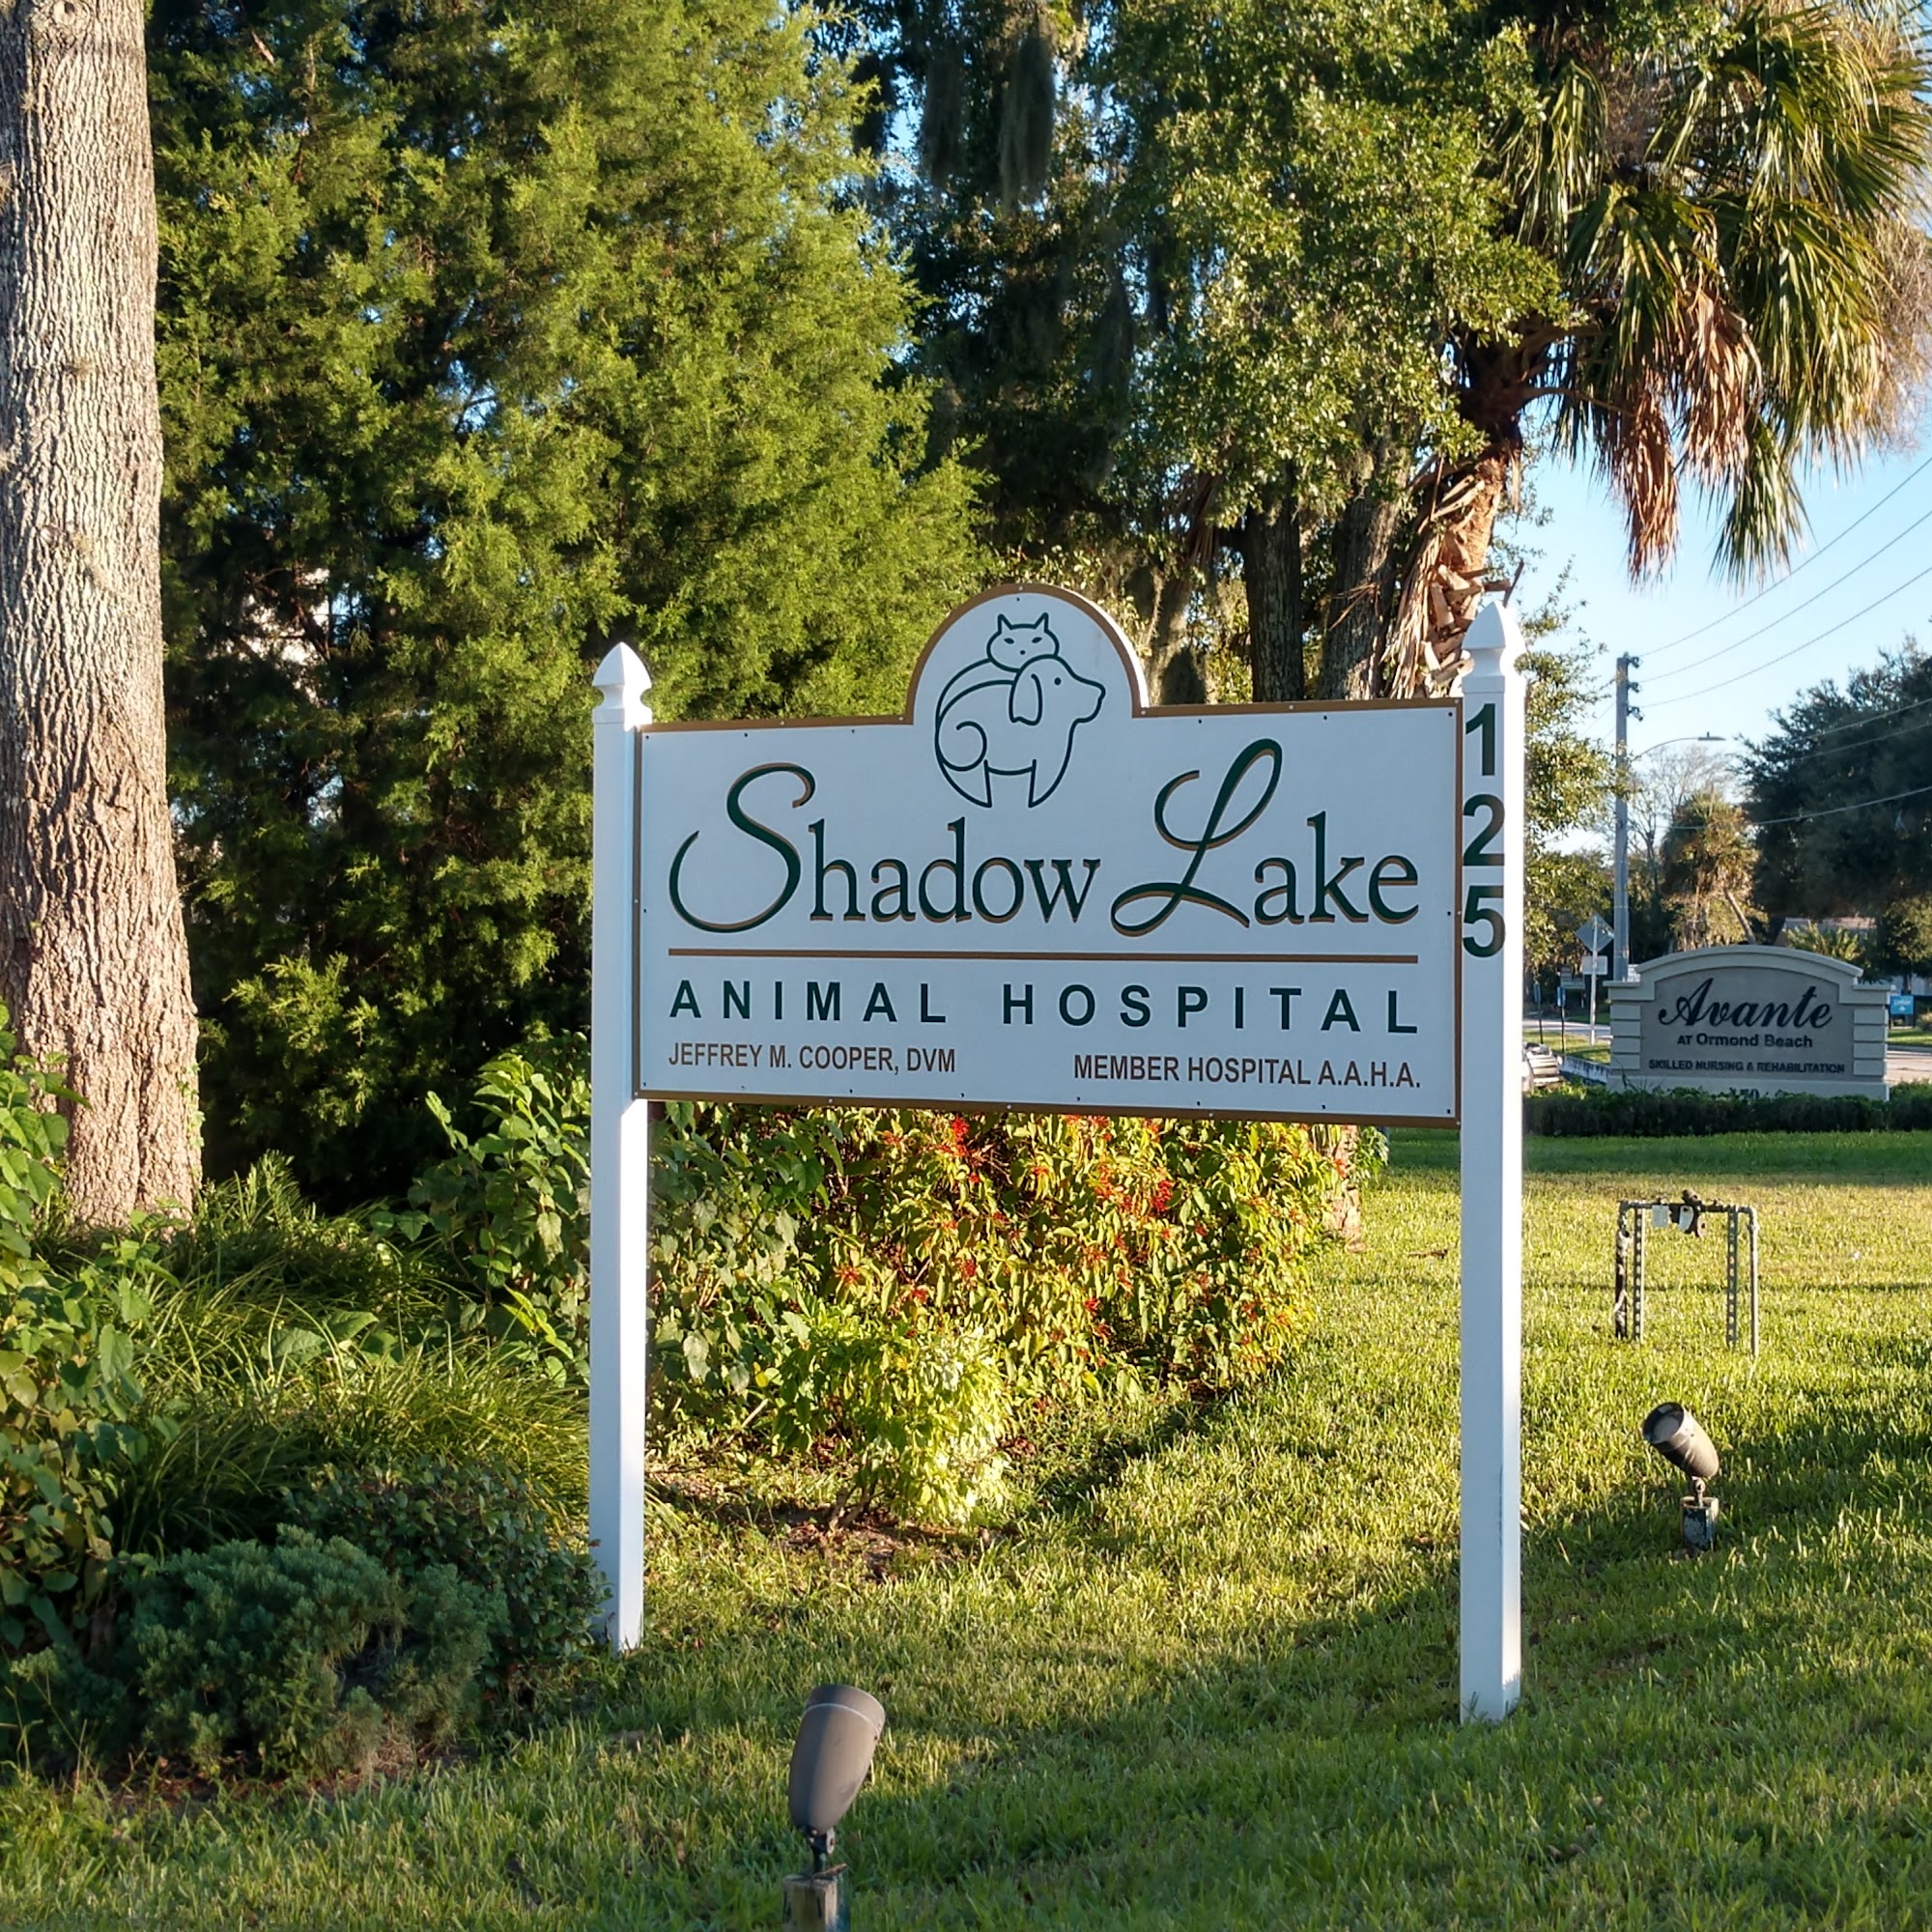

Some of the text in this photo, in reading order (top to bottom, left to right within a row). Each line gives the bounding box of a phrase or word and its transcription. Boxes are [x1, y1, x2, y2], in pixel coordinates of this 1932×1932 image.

[668, 737, 1420, 938] Shadow Lake
[1462, 703, 1505, 958] 125
[669, 980, 1418, 1035] ANIMAL HOSPITAL
[1658, 977, 1833, 1029] Avante
[668, 1042, 955, 1075] JEFFREY M. COOPER, DVM
[1696, 1033, 1759, 1047] Ormond
[1764, 1034, 1813, 1048] Beach
[1073, 1054, 1421, 1089] MEMBER HOSPITAL A.A.H.A.
[1648, 1059, 1692, 1070] SKILLED
[1695, 1060, 1745, 1072] NURSING
[1757, 1062, 1845, 1074] REHABILITATION
